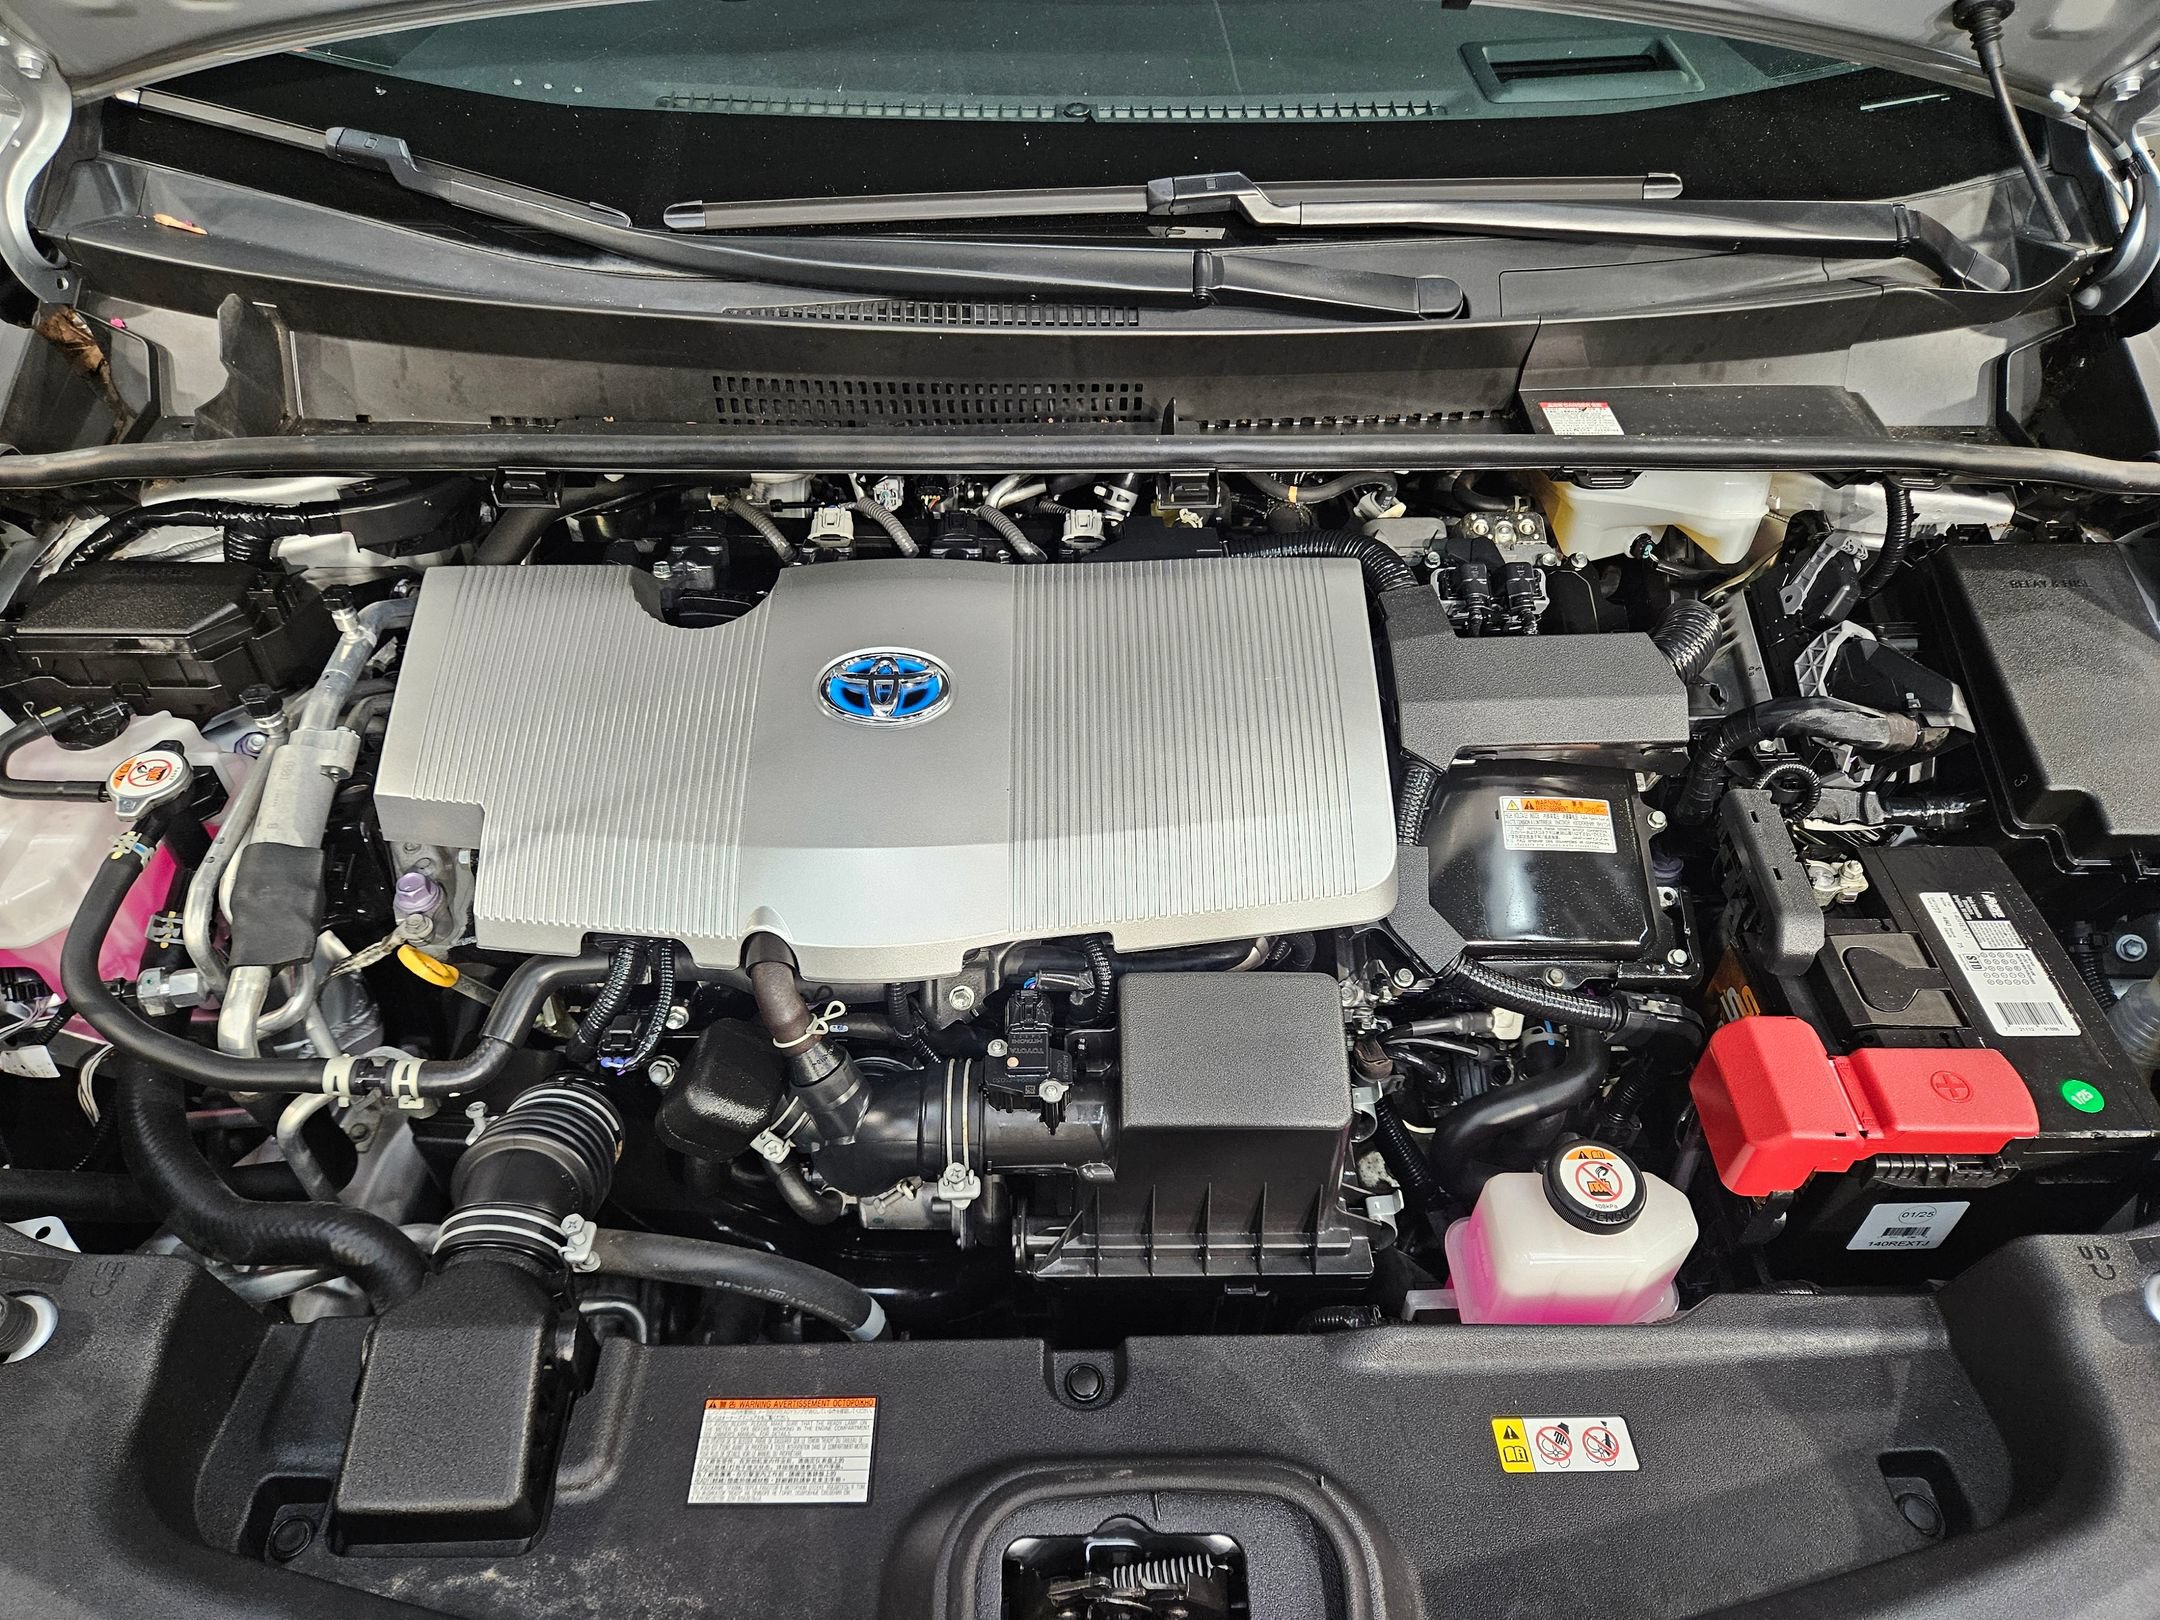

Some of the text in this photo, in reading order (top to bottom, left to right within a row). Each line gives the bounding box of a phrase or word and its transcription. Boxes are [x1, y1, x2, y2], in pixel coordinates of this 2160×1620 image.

[2010, 580, 2046, 588] RELAY
[1966, 955, 1983, 970] STD
[2071, 1089, 2094, 1105] 1/25
[1586, 1209, 1630, 1222] DENSO
[773, 1400, 830, 1408] AVERTISSEMENT
[833, 1399, 873, 1407] ОСТОРОЖНО
